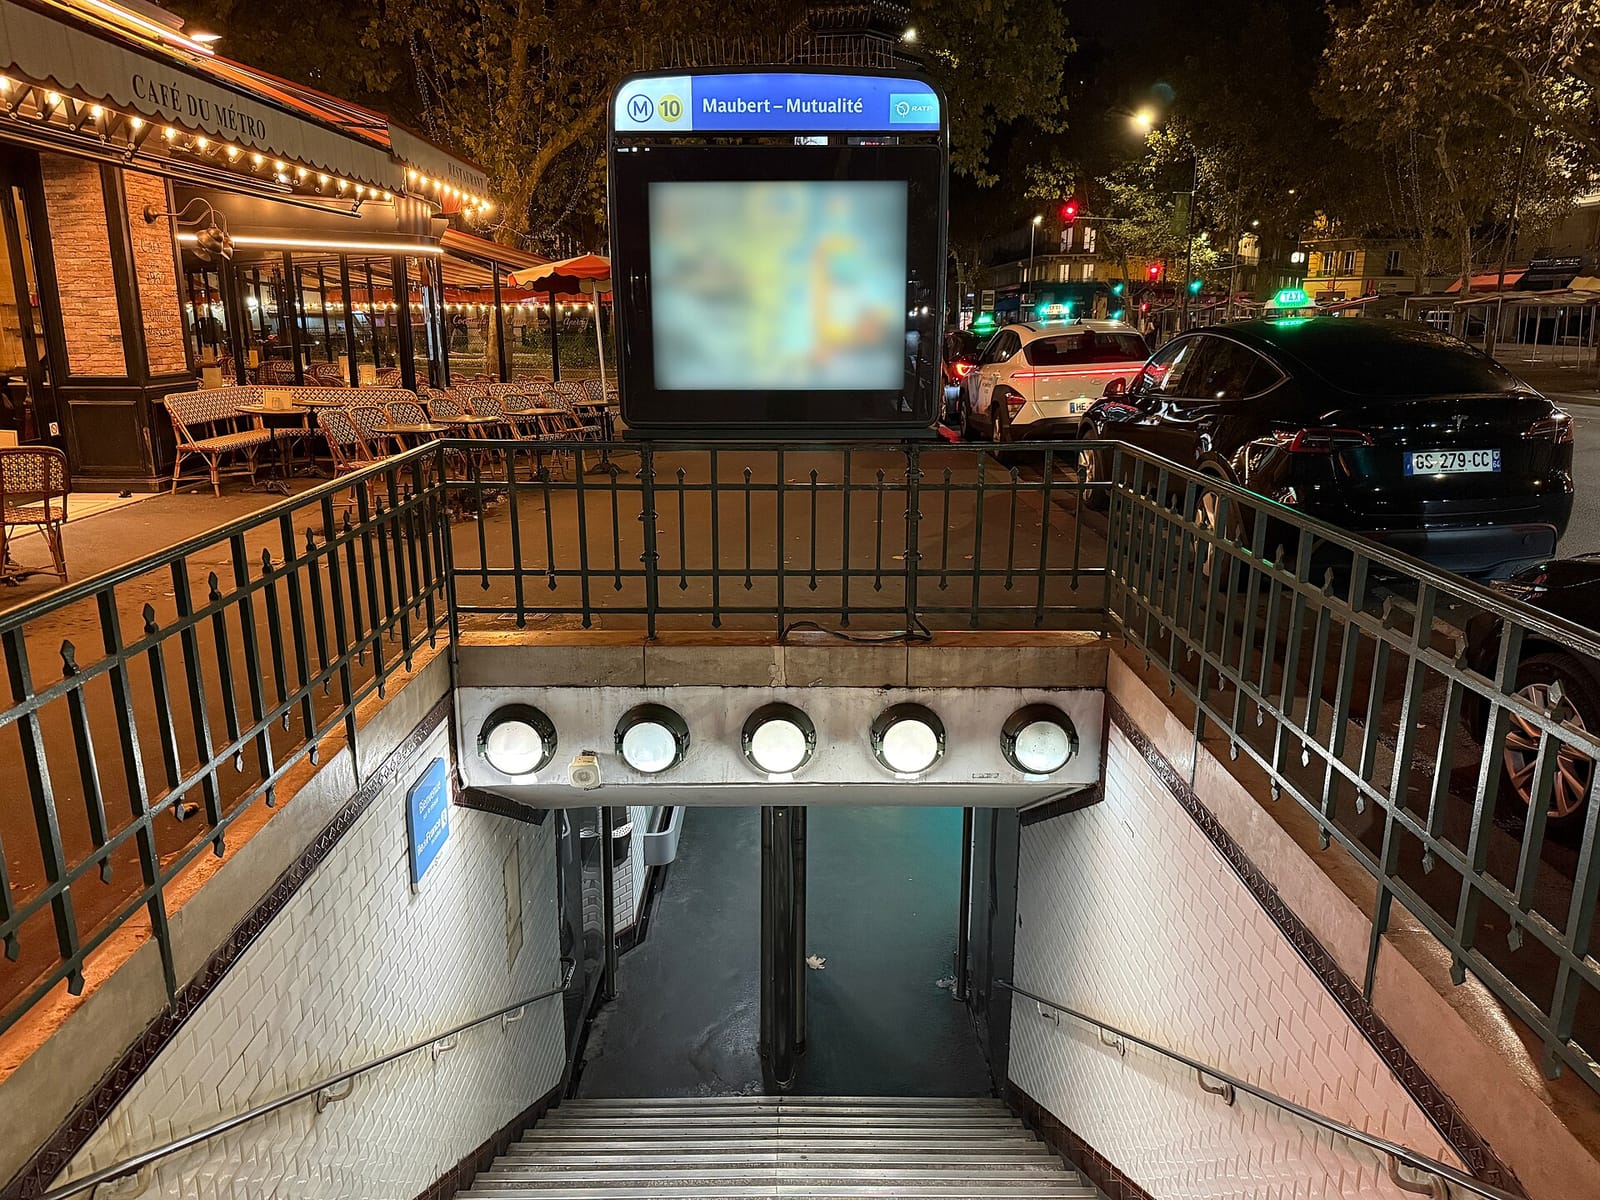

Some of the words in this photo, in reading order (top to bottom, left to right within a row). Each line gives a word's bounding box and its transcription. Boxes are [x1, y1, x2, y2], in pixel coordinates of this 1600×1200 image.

[132, 74, 182, 112] CAFÉ
[187, 94, 210, 121] DU
[214, 103, 266, 140] MÉTRO
[660, 100, 680, 117] 10
[702, 97, 771, 113] Maubert
[786, 97, 863, 113] Mutualité
[447, 162, 484, 190] RESTAURANT
